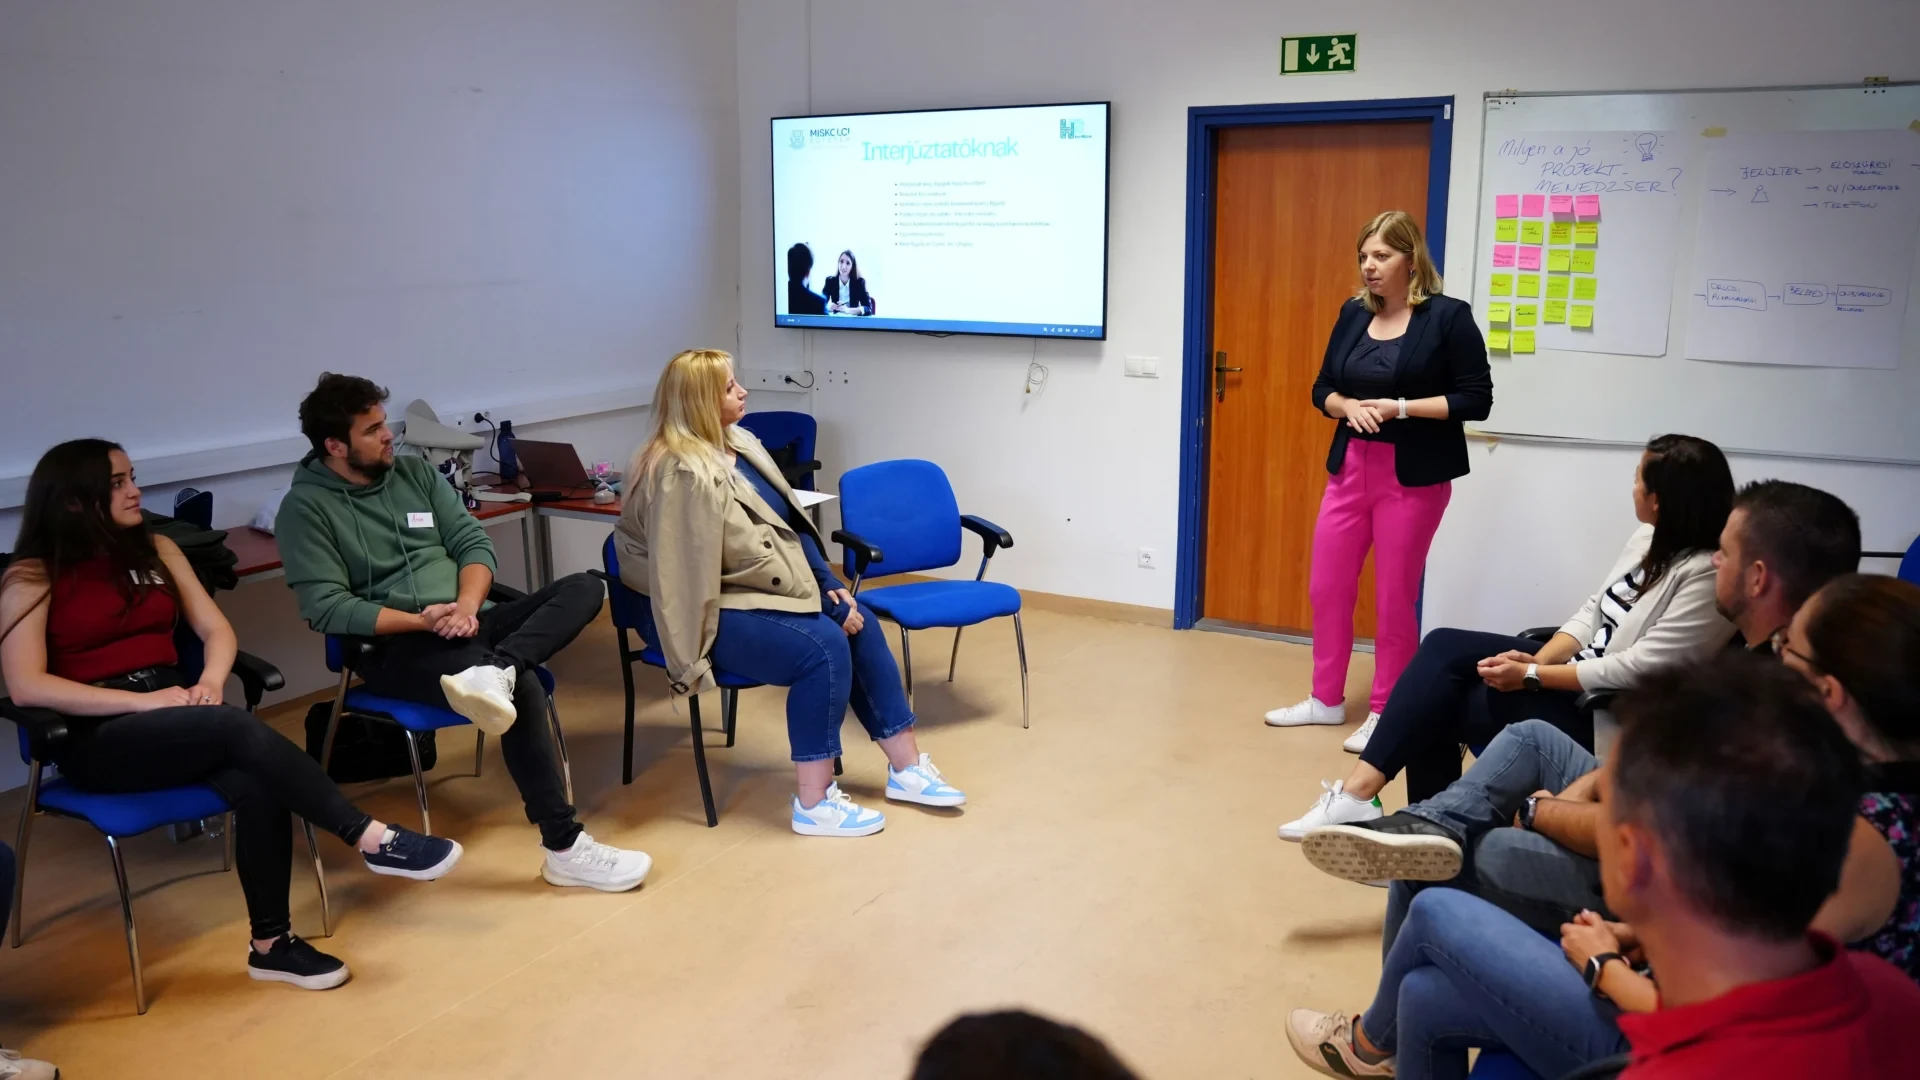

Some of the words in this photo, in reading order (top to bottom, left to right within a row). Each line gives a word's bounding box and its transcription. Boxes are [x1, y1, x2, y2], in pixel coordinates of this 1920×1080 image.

[1499, 138, 1547, 165] Milyen
[1553, 145, 1564, 155] a
[1566, 139, 1592, 164] jó
